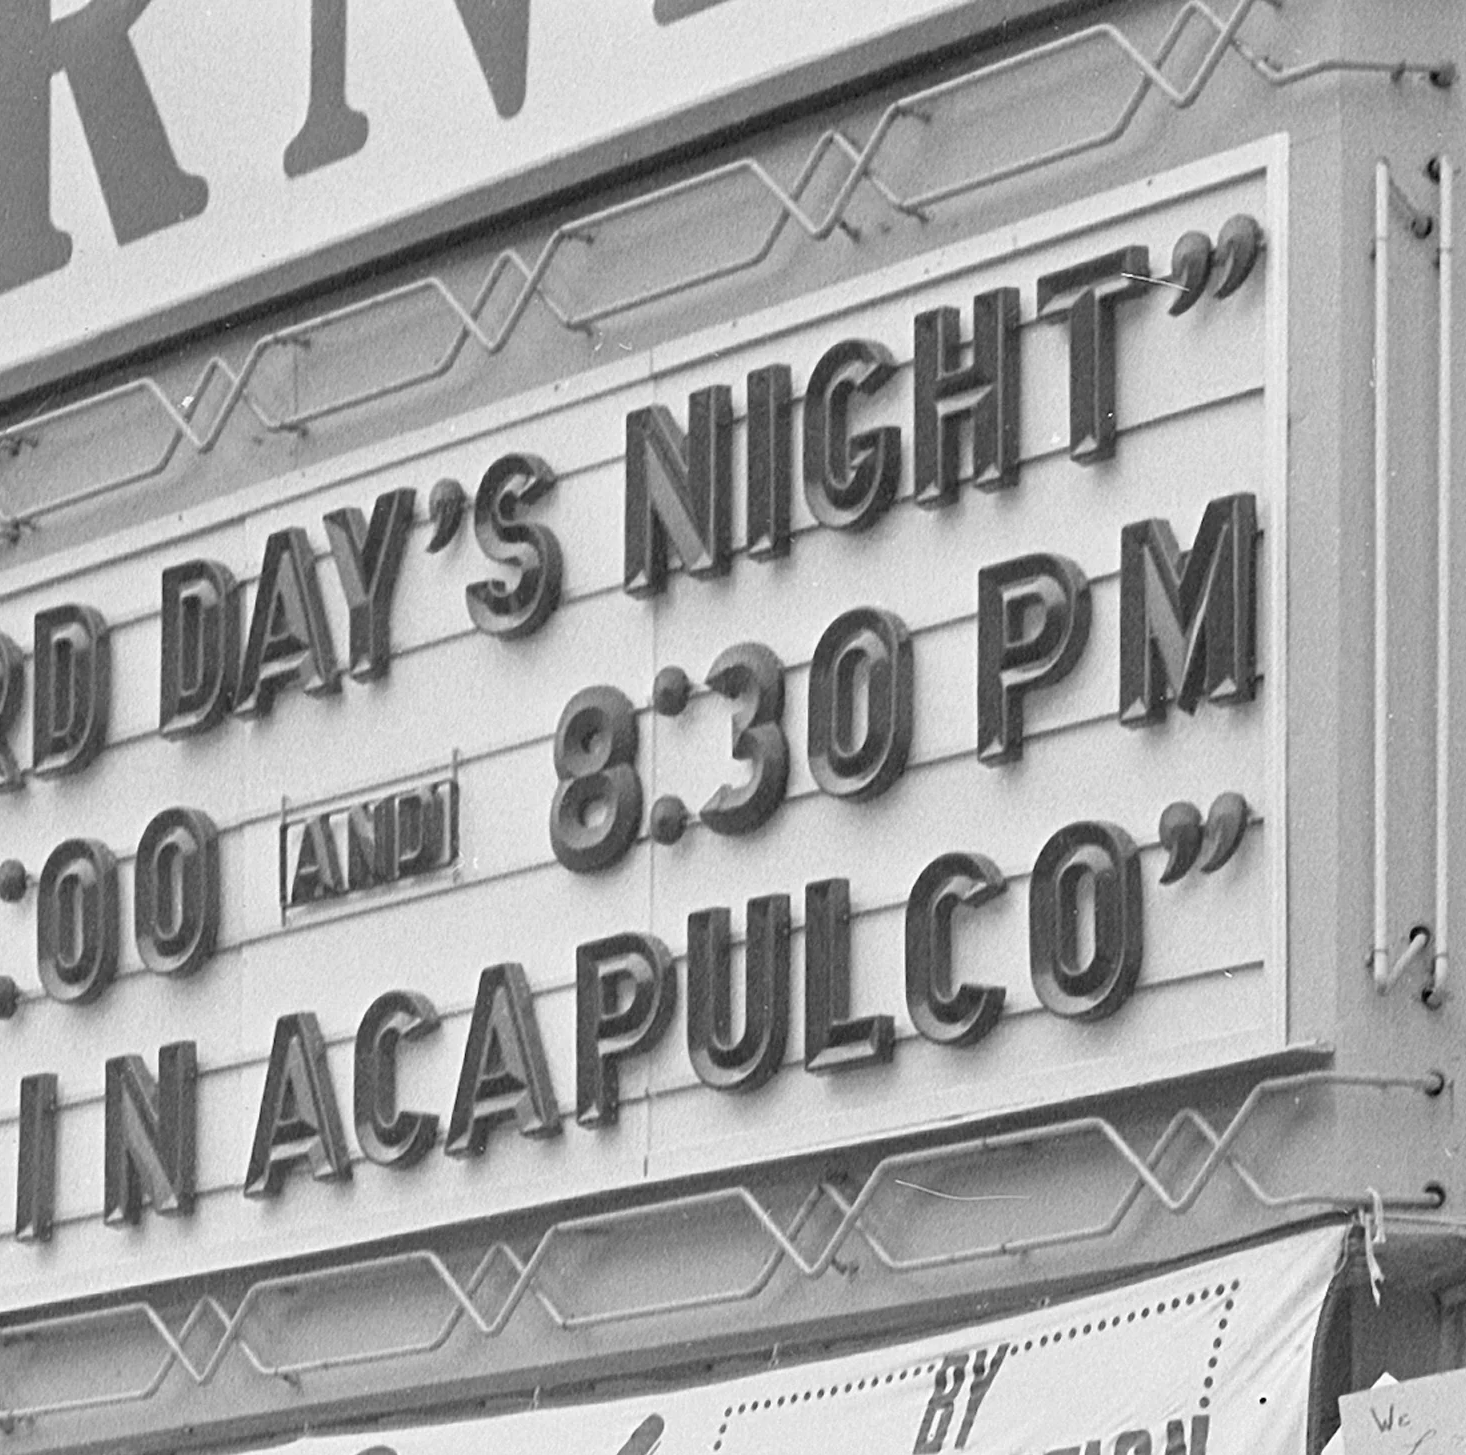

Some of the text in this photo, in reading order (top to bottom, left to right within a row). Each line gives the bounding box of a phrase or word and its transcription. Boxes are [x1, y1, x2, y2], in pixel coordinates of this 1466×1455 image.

[160, 454, 564, 738] DAY'S
[285, 780, 458, 908] AND
[550, 607, 913, 874] 8:30
[15, 1039, 197, 1242] IN
[913, 1341, 1010, 1455] BY
[1370, 1403, 1411, 1434] We
